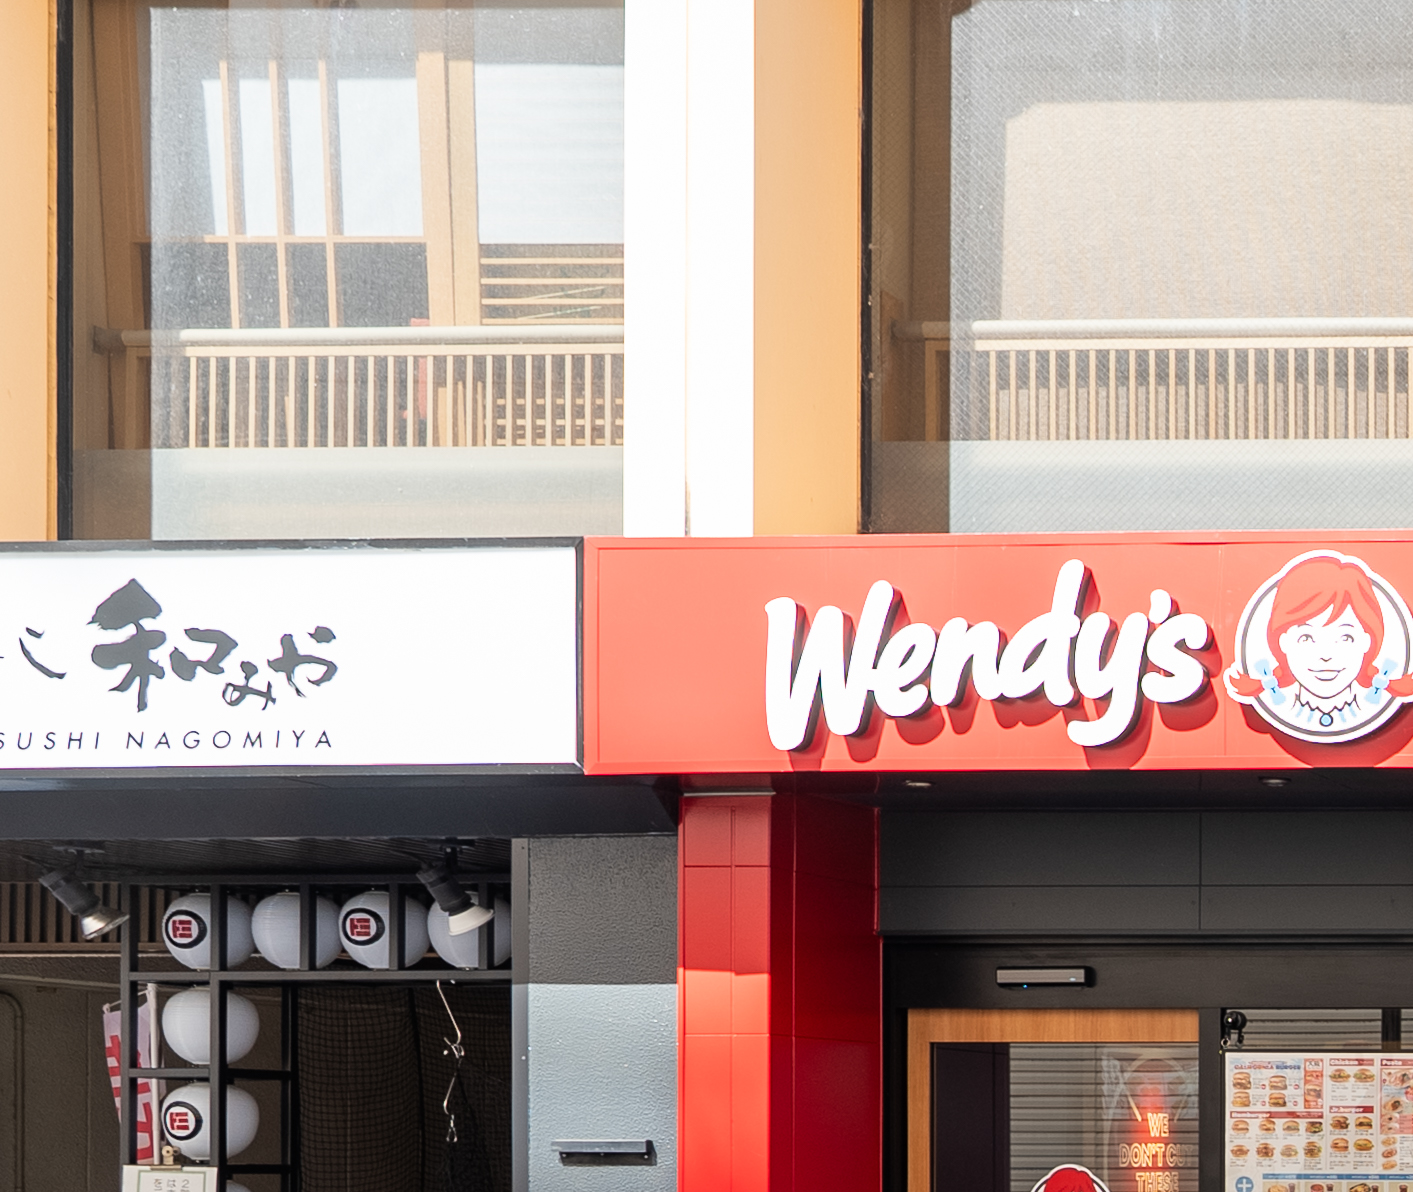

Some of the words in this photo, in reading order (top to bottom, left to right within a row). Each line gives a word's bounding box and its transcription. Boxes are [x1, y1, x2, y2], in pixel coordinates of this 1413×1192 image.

[86, 578, 338, 713] 和みや
[764, 557, 1208, 752] Wendy's
[126, 730, 333, 749] NAGOMIYA
[1147, 1112, 1169, 1137] WE
[1119, 1142, 1165, 1167] DON'T
